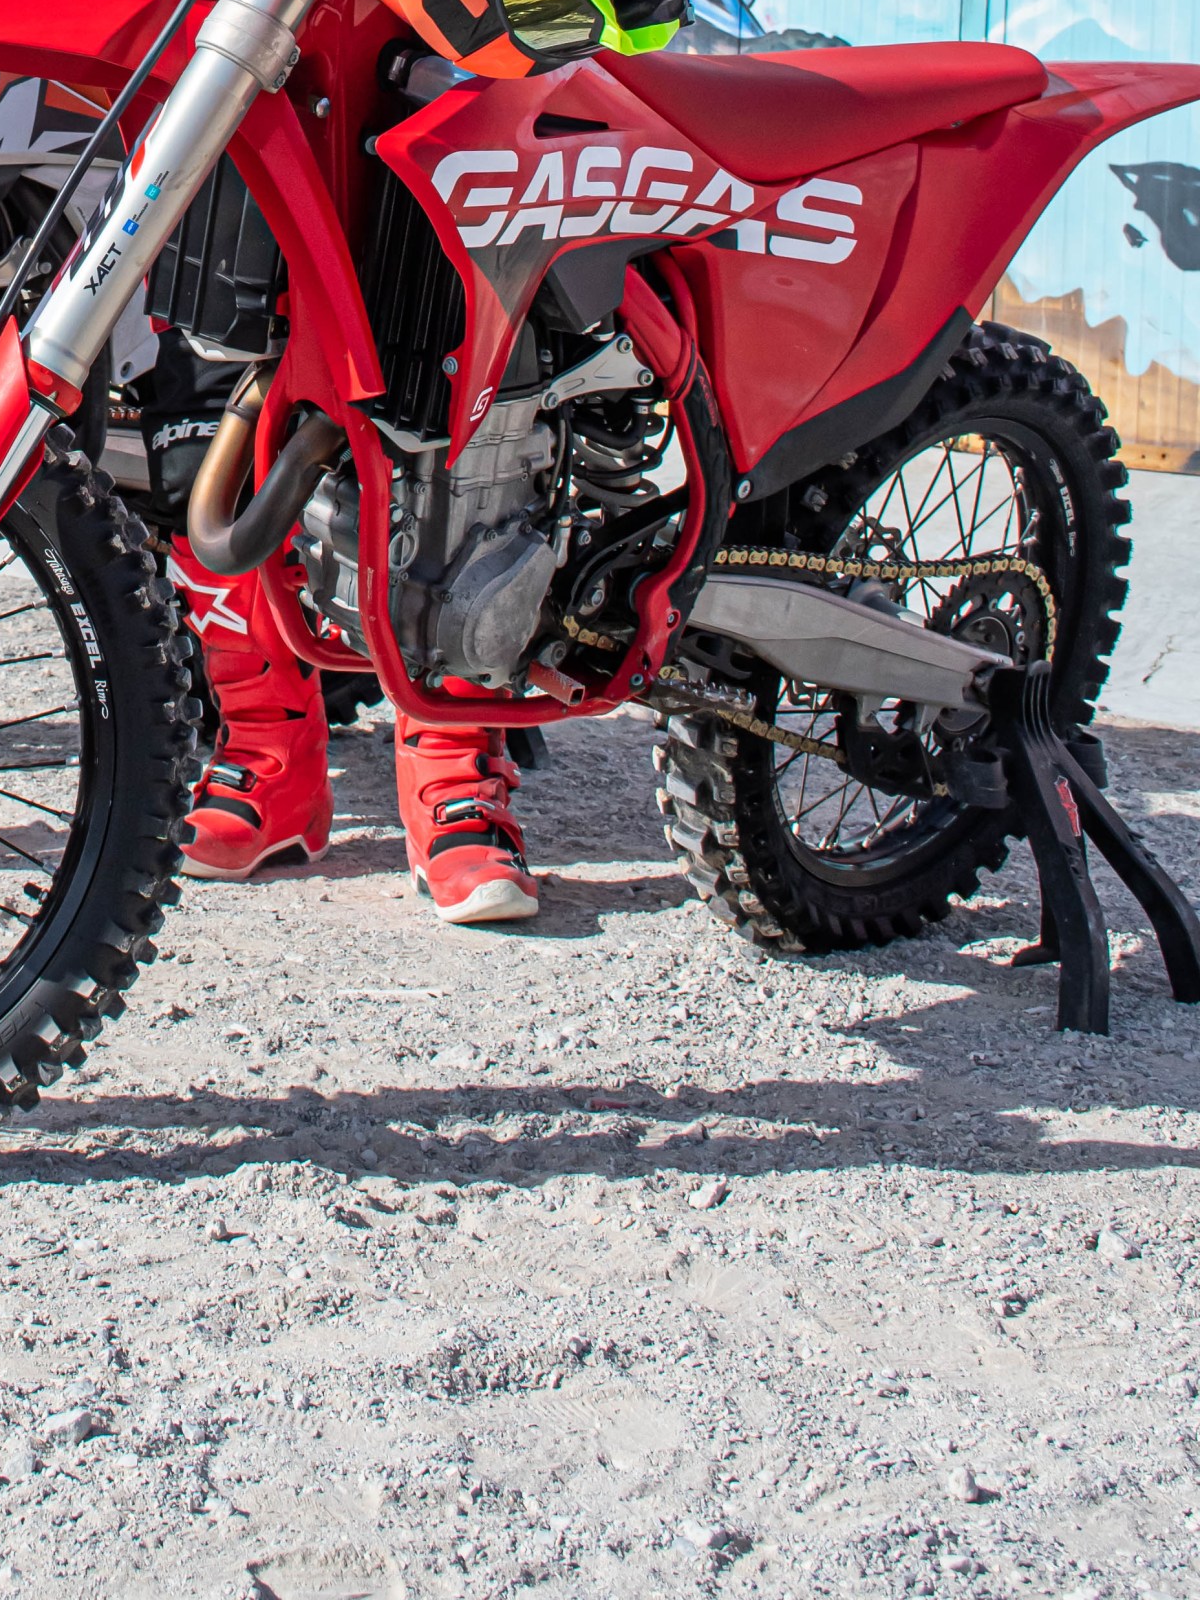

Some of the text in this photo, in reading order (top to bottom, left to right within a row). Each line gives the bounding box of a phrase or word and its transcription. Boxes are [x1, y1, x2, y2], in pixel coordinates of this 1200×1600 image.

[431, 146, 864, 265] GASGAS
[84, 242, 122, 296] XACT
[152, 418, 223, 451] alpine
[44, 547, 109, 720] Takasago EXCEL Rim
